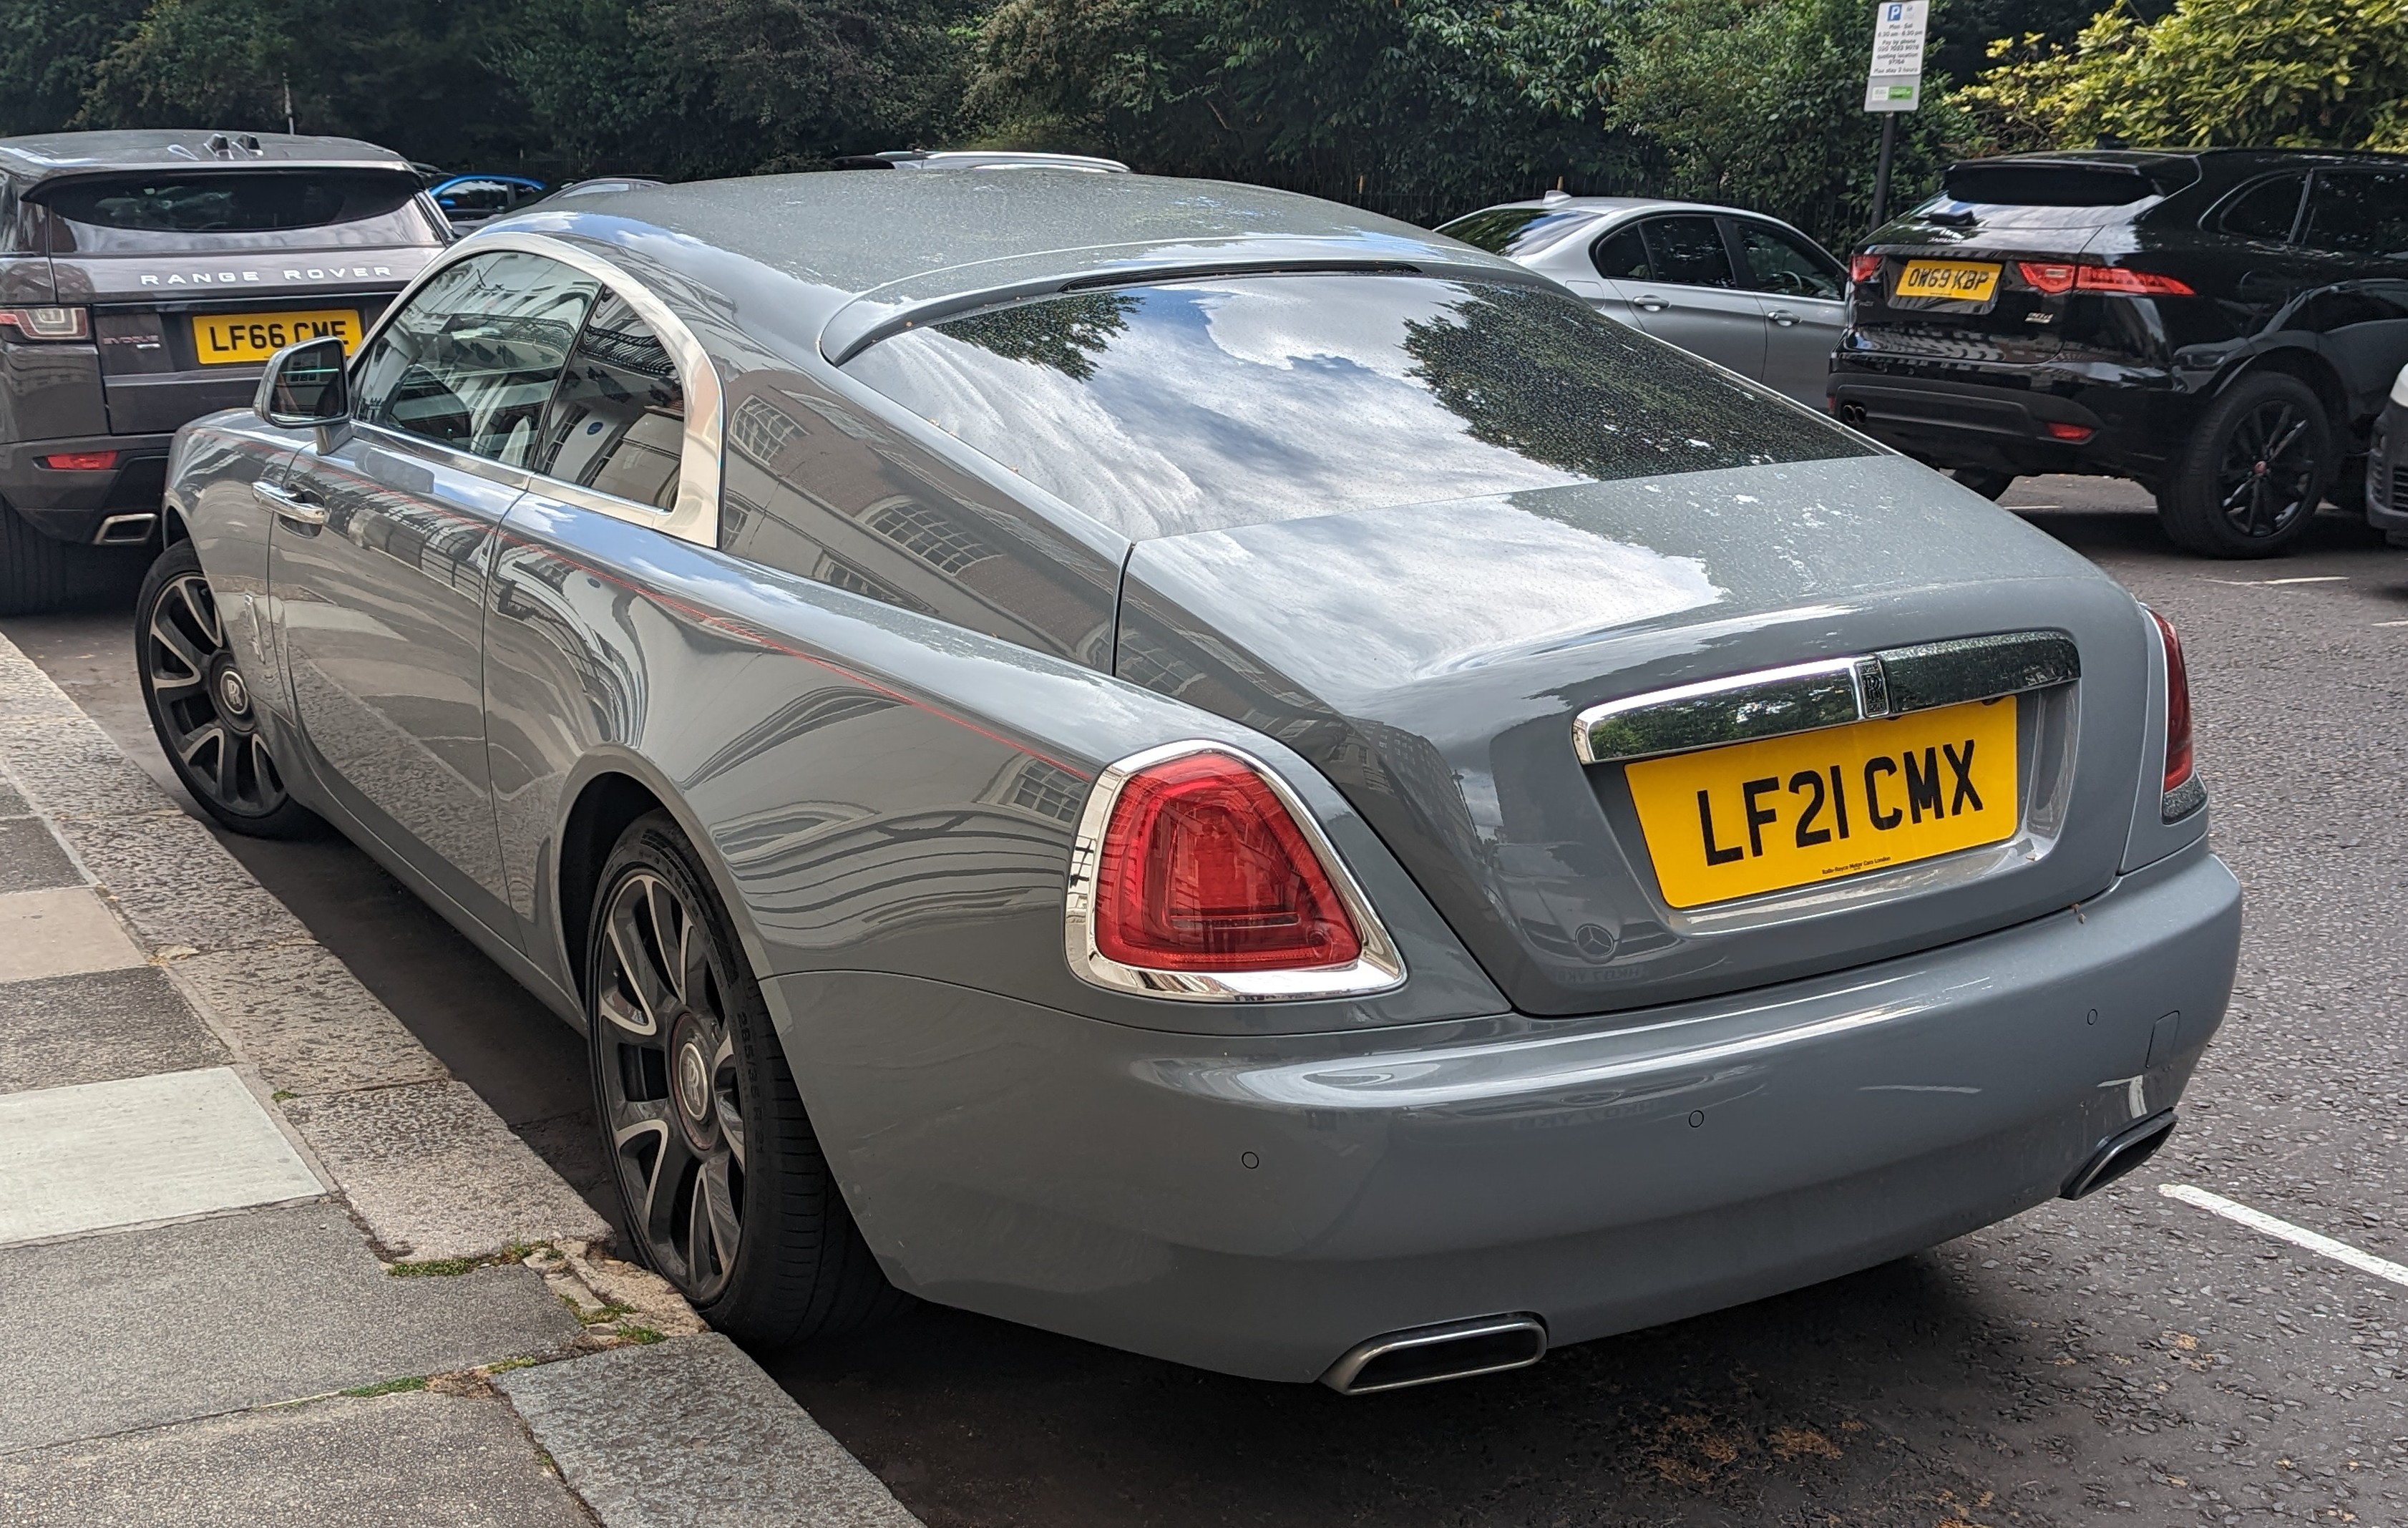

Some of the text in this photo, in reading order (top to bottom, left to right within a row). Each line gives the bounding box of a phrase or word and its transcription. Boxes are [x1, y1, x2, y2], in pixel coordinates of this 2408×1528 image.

[1890, 6, 1901, 20] P
[140, 267, 391, 286] RANGE ROVER
[1951, 269, 1989, 291] KBP
[208, 324, 286, 351] LF66
[1697, 739, 1984, 867] LF21 CMX
